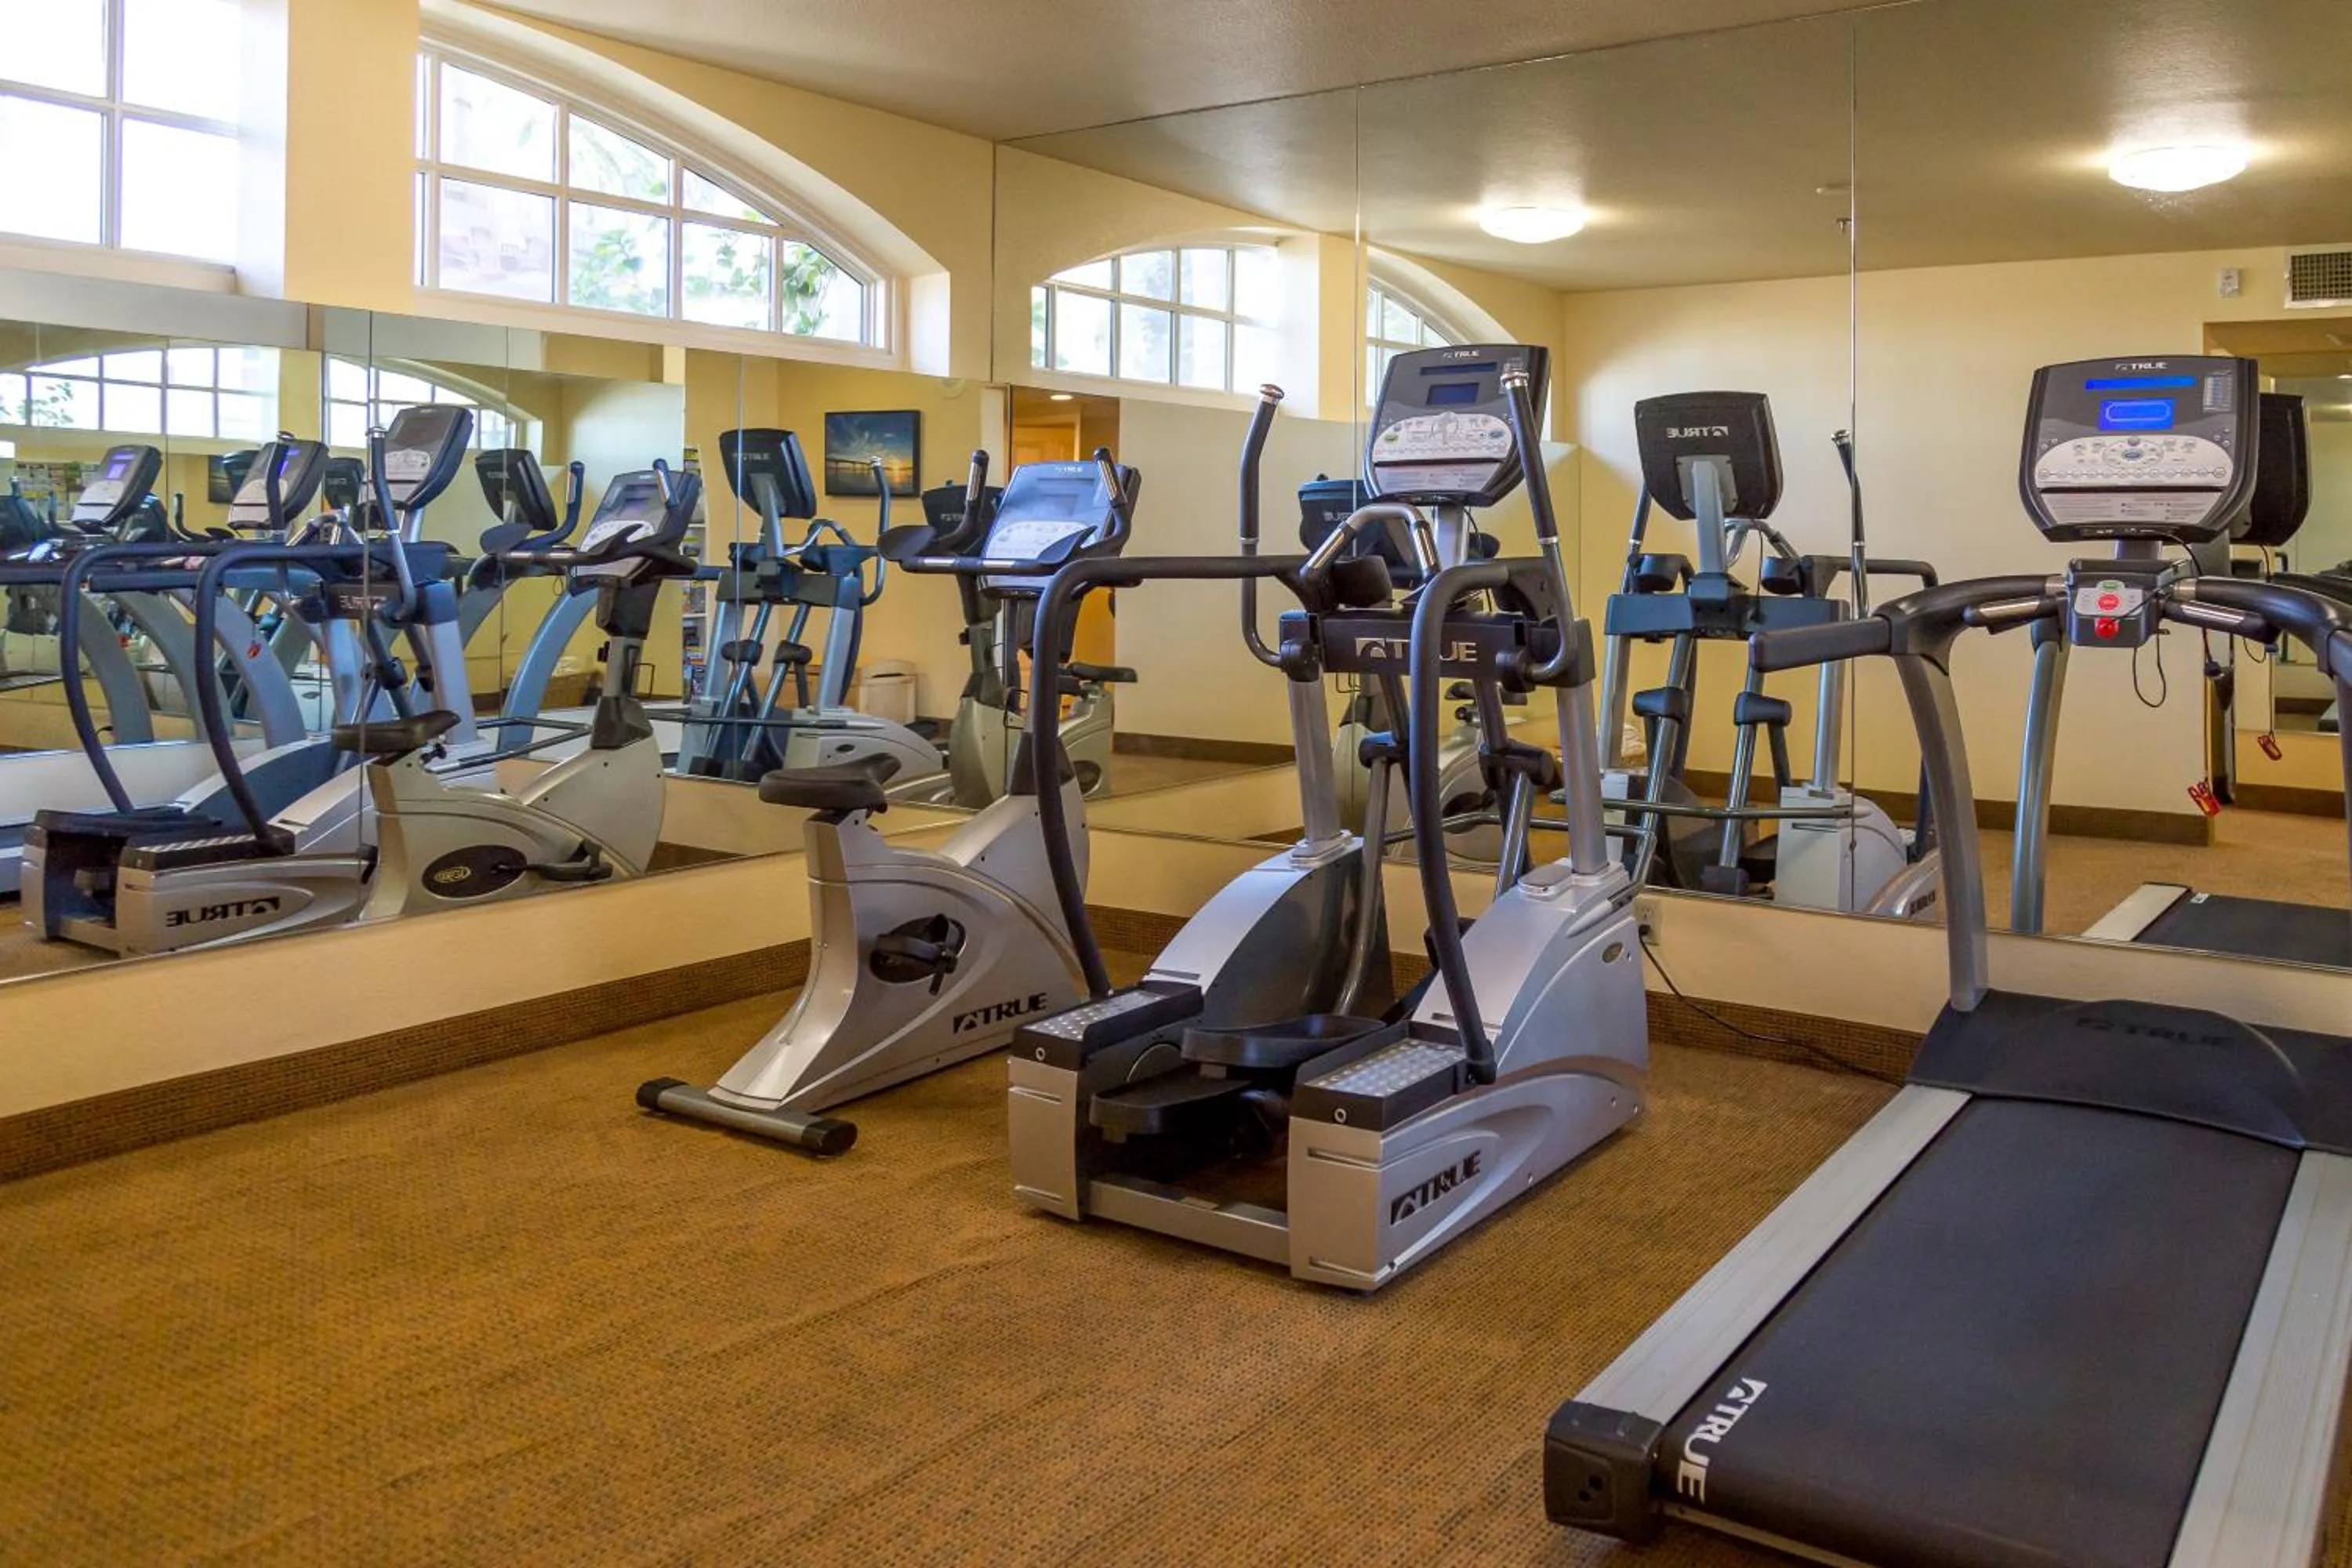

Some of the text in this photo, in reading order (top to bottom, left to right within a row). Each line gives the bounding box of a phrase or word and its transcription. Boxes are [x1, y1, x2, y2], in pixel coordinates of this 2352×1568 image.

[2130, 361, 2169, 370] TRUE
[1385, 637, 1478, 662] TUE
[978, 992, 1047, 1025] TRUE
[1414, 1149, 1482, 1207] TRUE
[1677, 1403, 1749, 1505] TRUE
